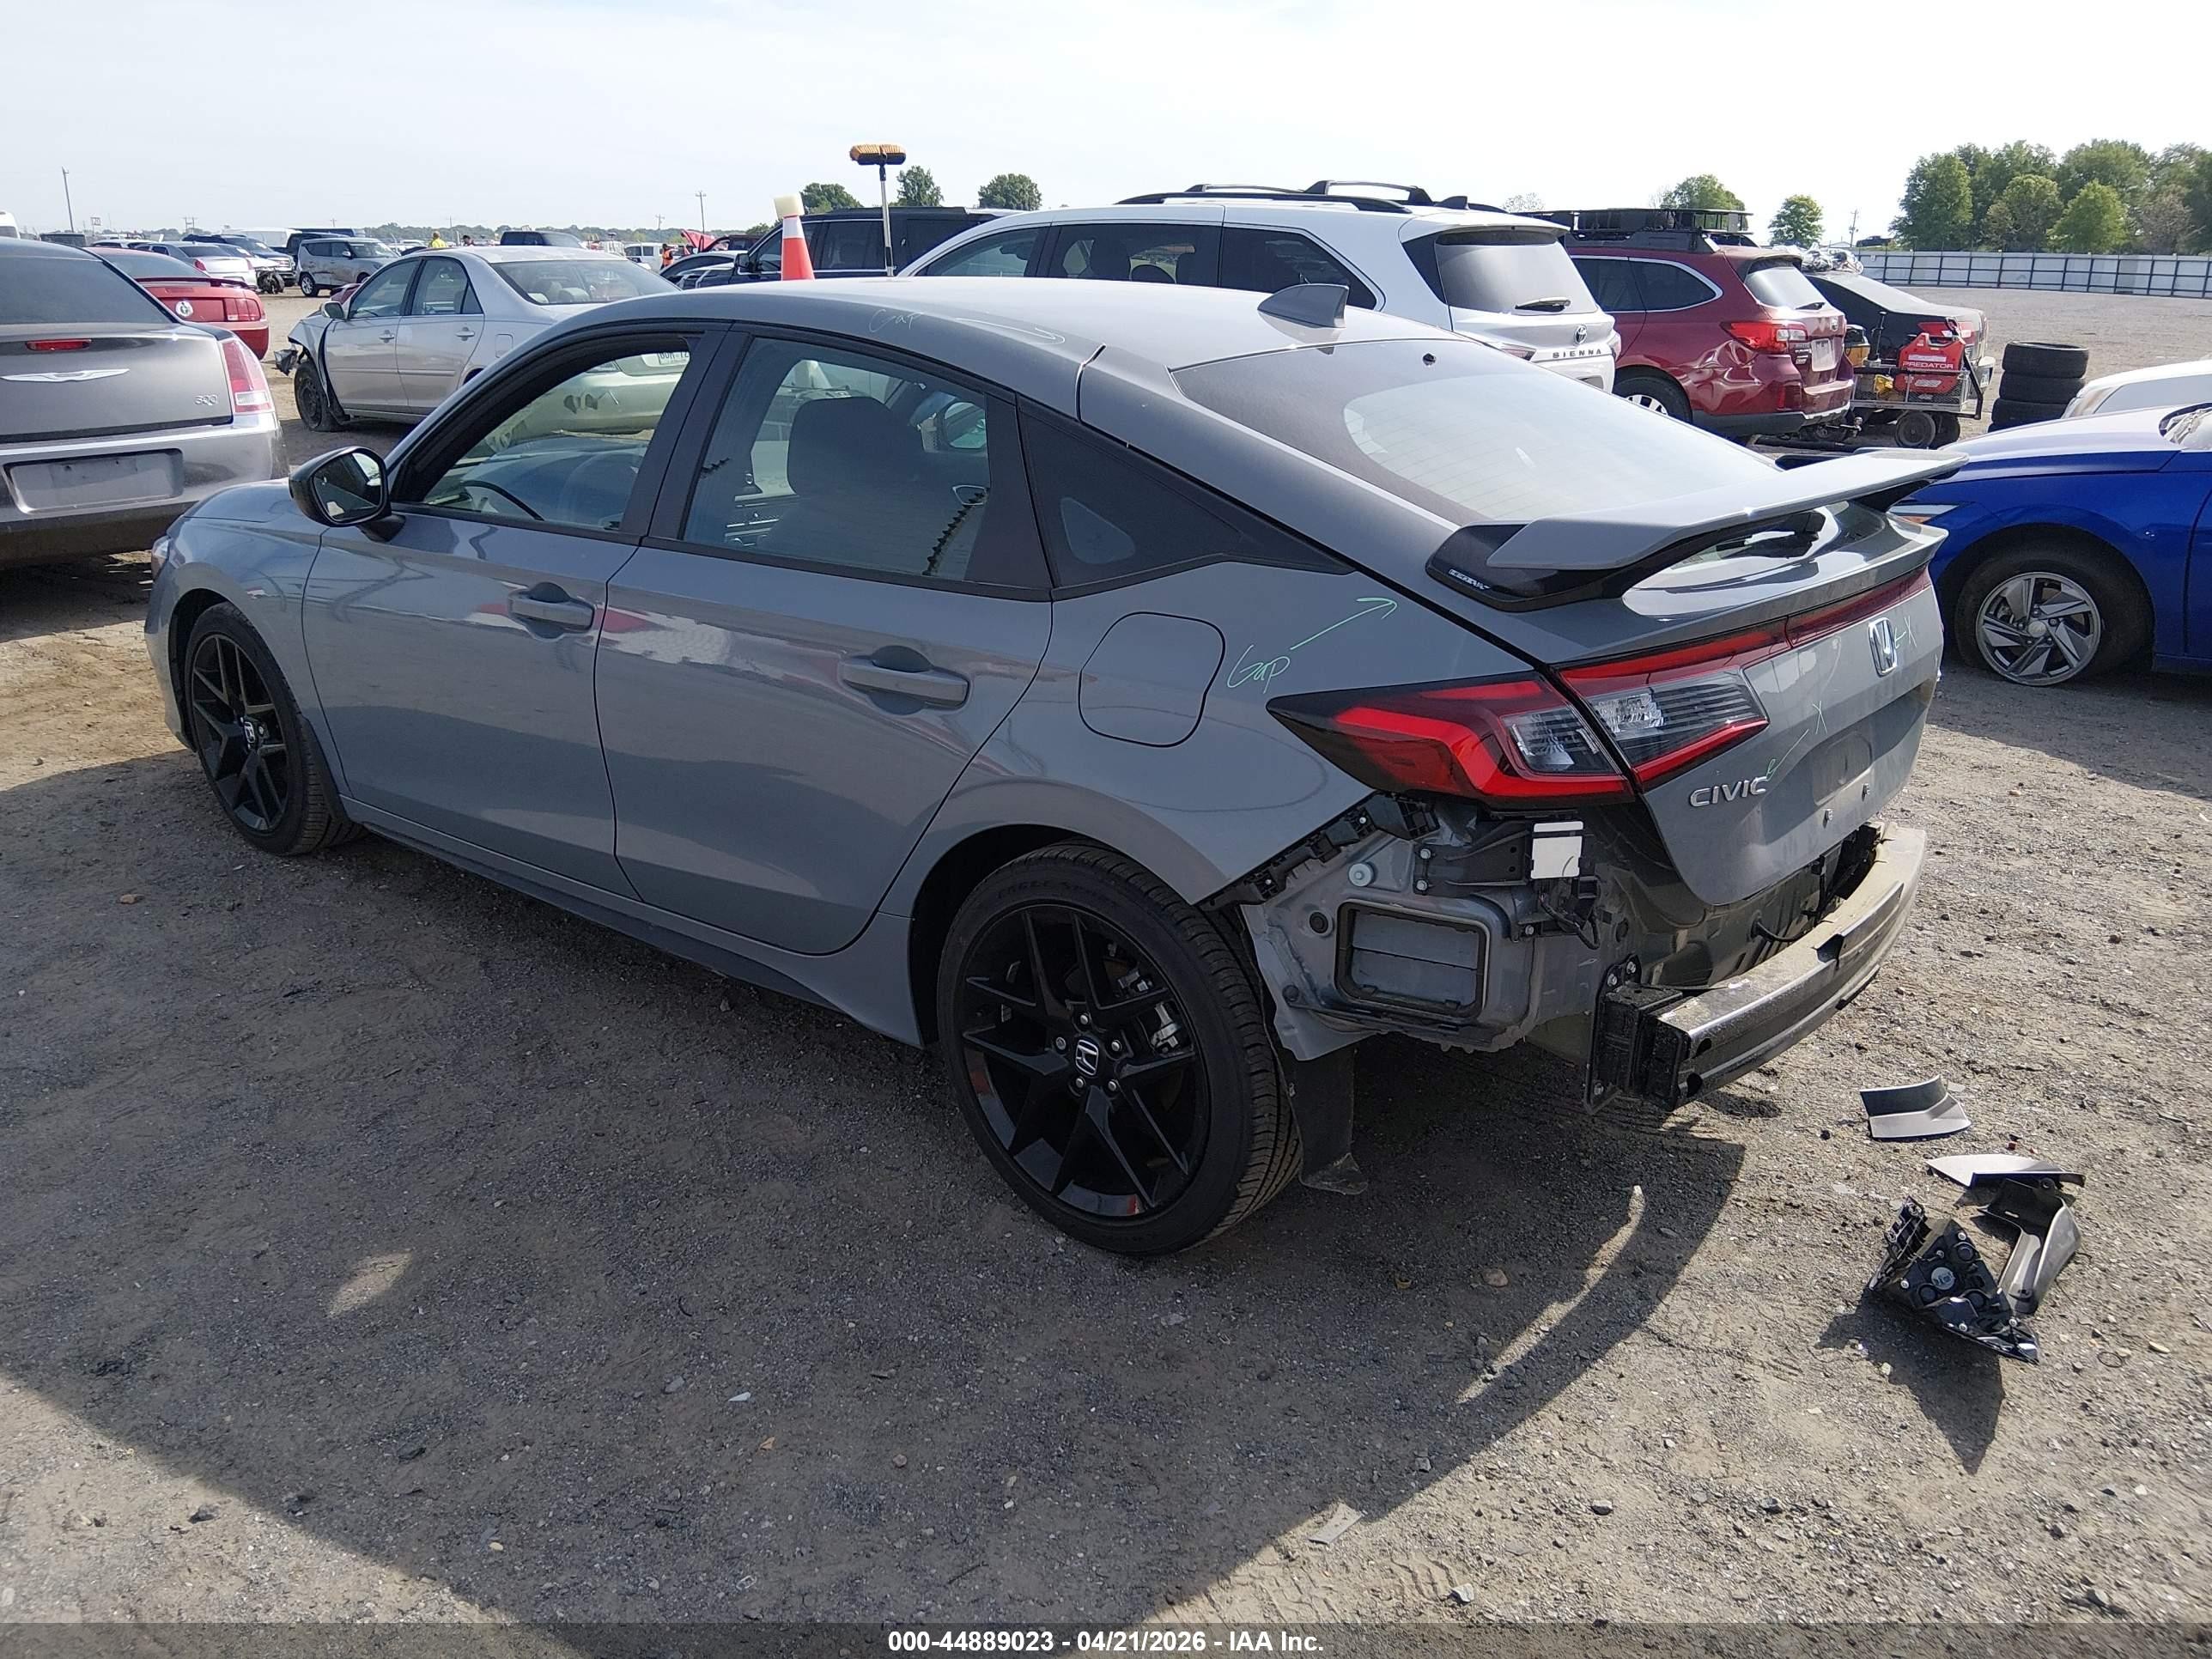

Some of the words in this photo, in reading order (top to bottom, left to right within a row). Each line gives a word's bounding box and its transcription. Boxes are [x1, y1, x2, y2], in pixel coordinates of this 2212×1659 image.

[1553, 349, 1601, 358] SIENNA
[193, 394, 218, 406] 300
[1227, 644, 1291, 695] Gap
[1690, 776, 1767, 807] CIVIC
